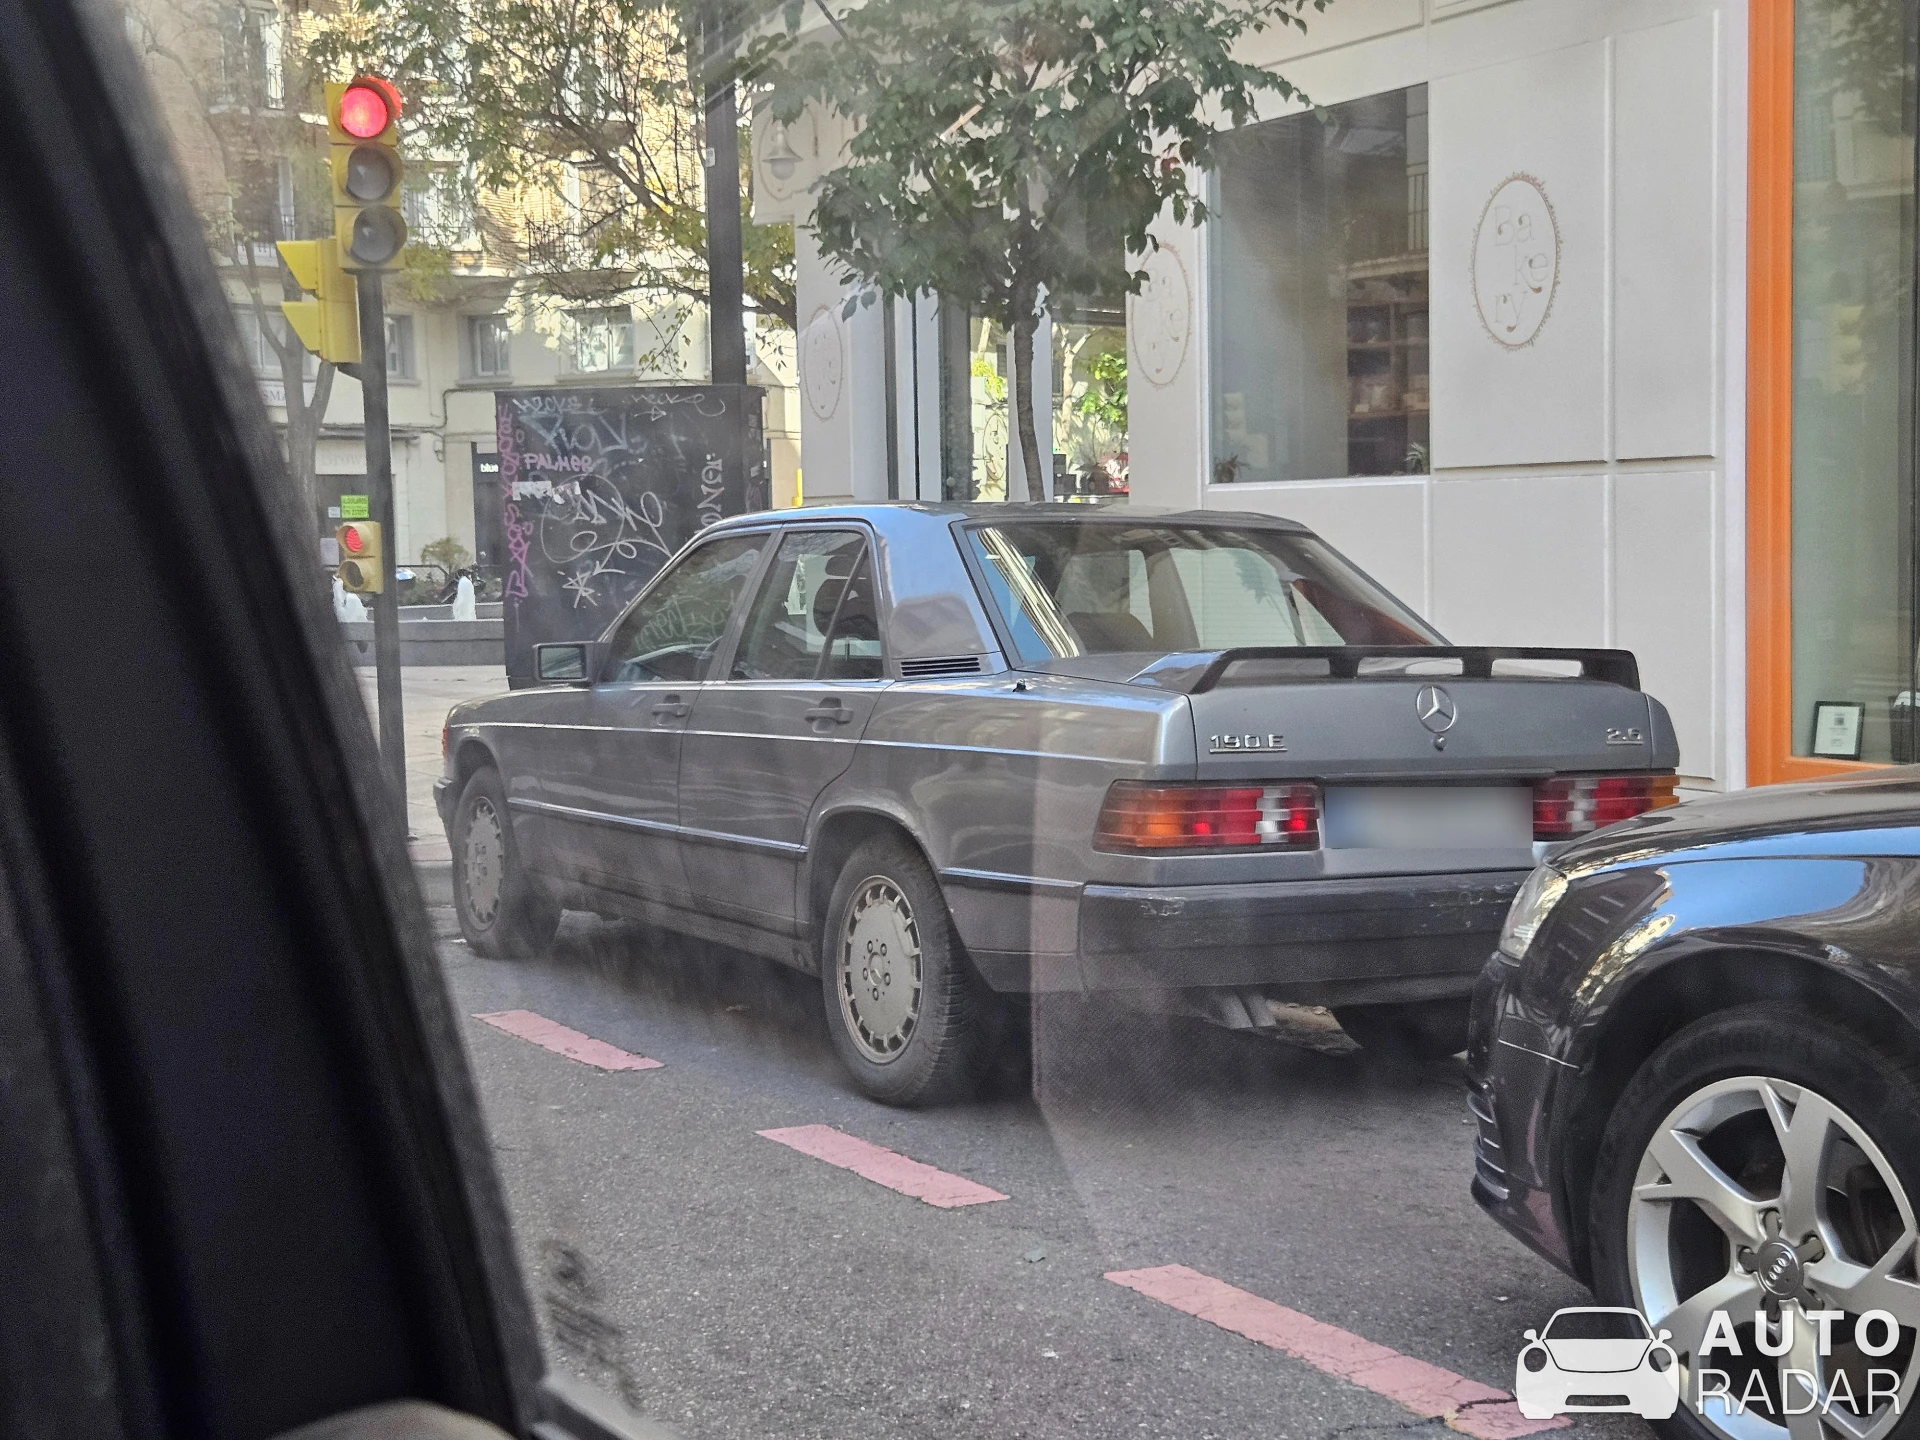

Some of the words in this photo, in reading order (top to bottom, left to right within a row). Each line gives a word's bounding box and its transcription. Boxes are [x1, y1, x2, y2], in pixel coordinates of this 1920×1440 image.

[1210, 734, 1261, 748] 190
[1268, 734, 1285, 748] E
[1606, 728, 1643, 742] 2.6
